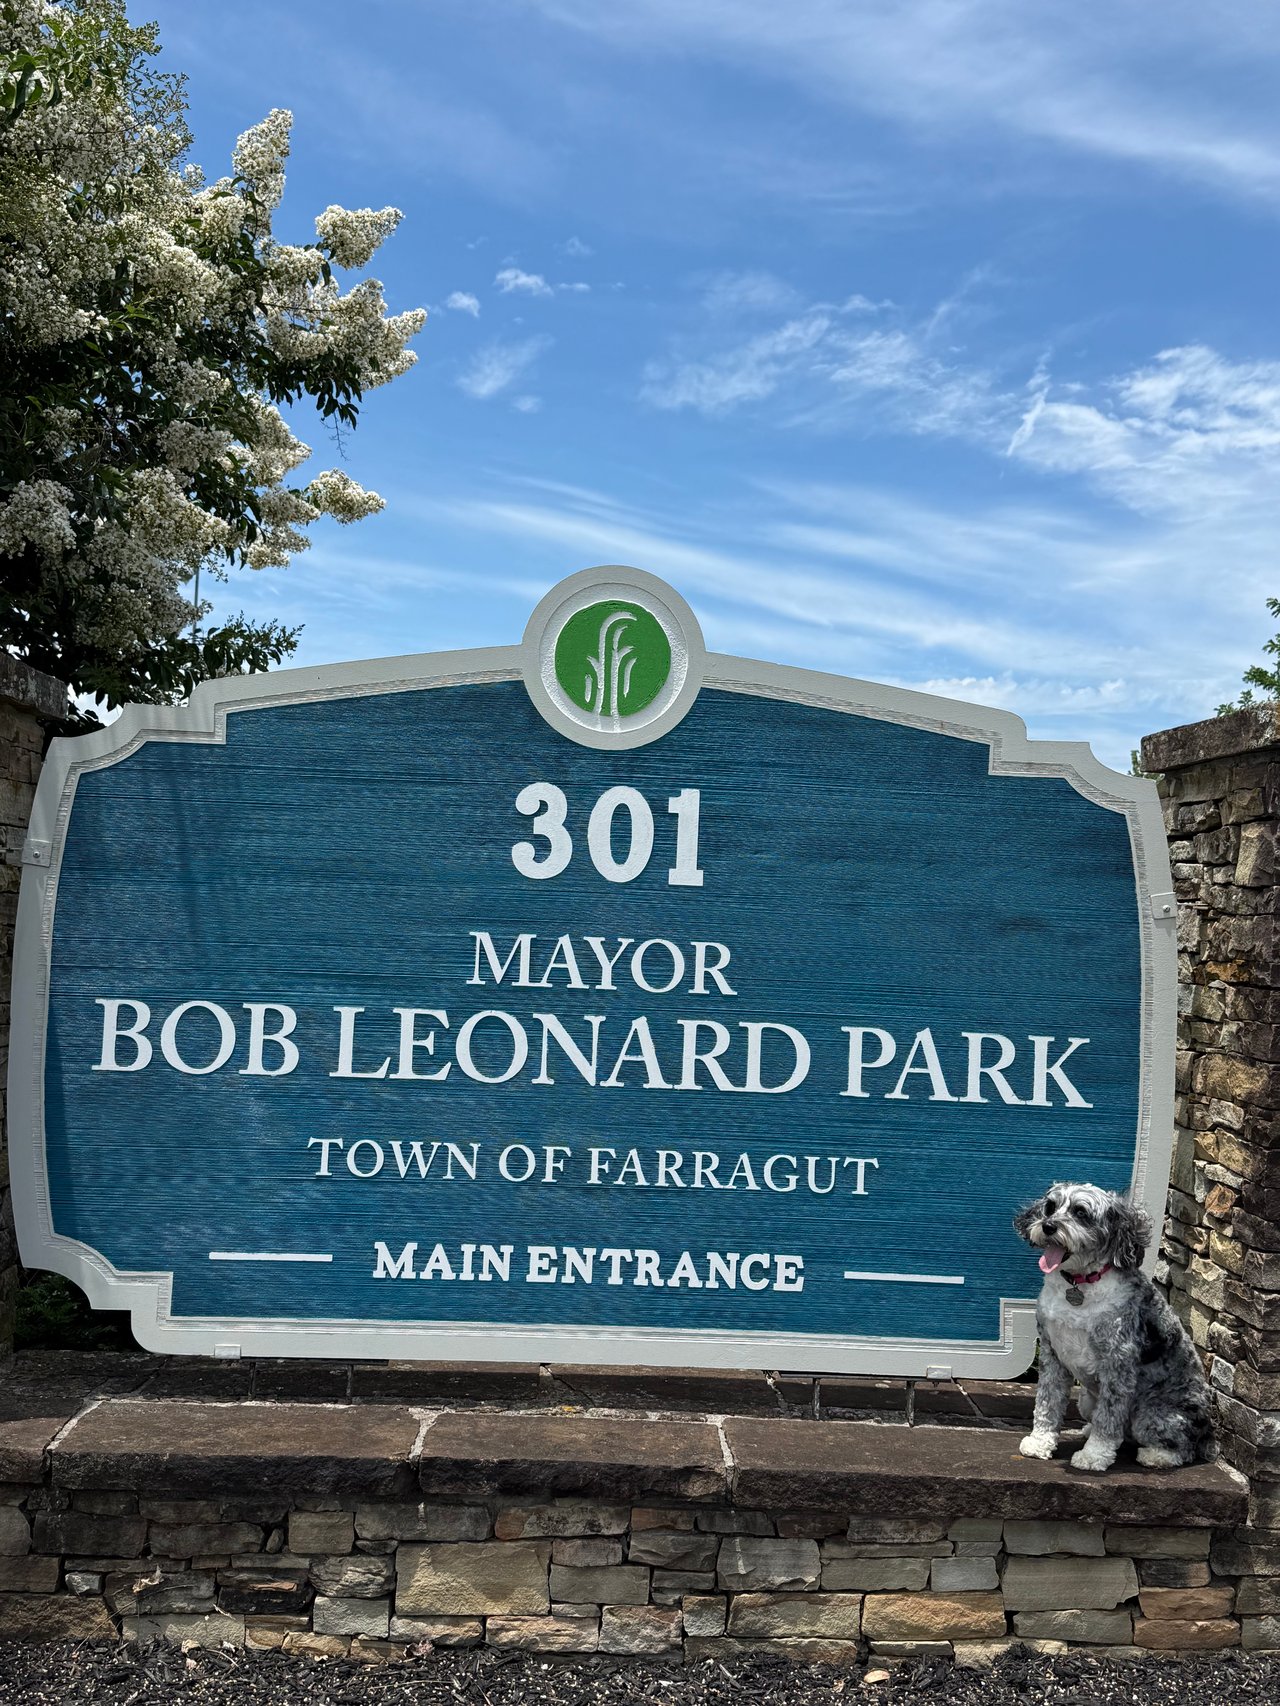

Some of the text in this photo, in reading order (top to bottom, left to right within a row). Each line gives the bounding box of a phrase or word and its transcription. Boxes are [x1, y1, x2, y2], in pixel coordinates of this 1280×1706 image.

[511, 782, 704, 887] 301
[466, 931, 737, 997] MAYOR
[92, 999, 1093, 1109] BOB LEONARD PARK
[308, 1137, 879, 1196] TOWN OF FARRAGUT
[373, 1242, 805, 1293] MAIN ENTRANCE
